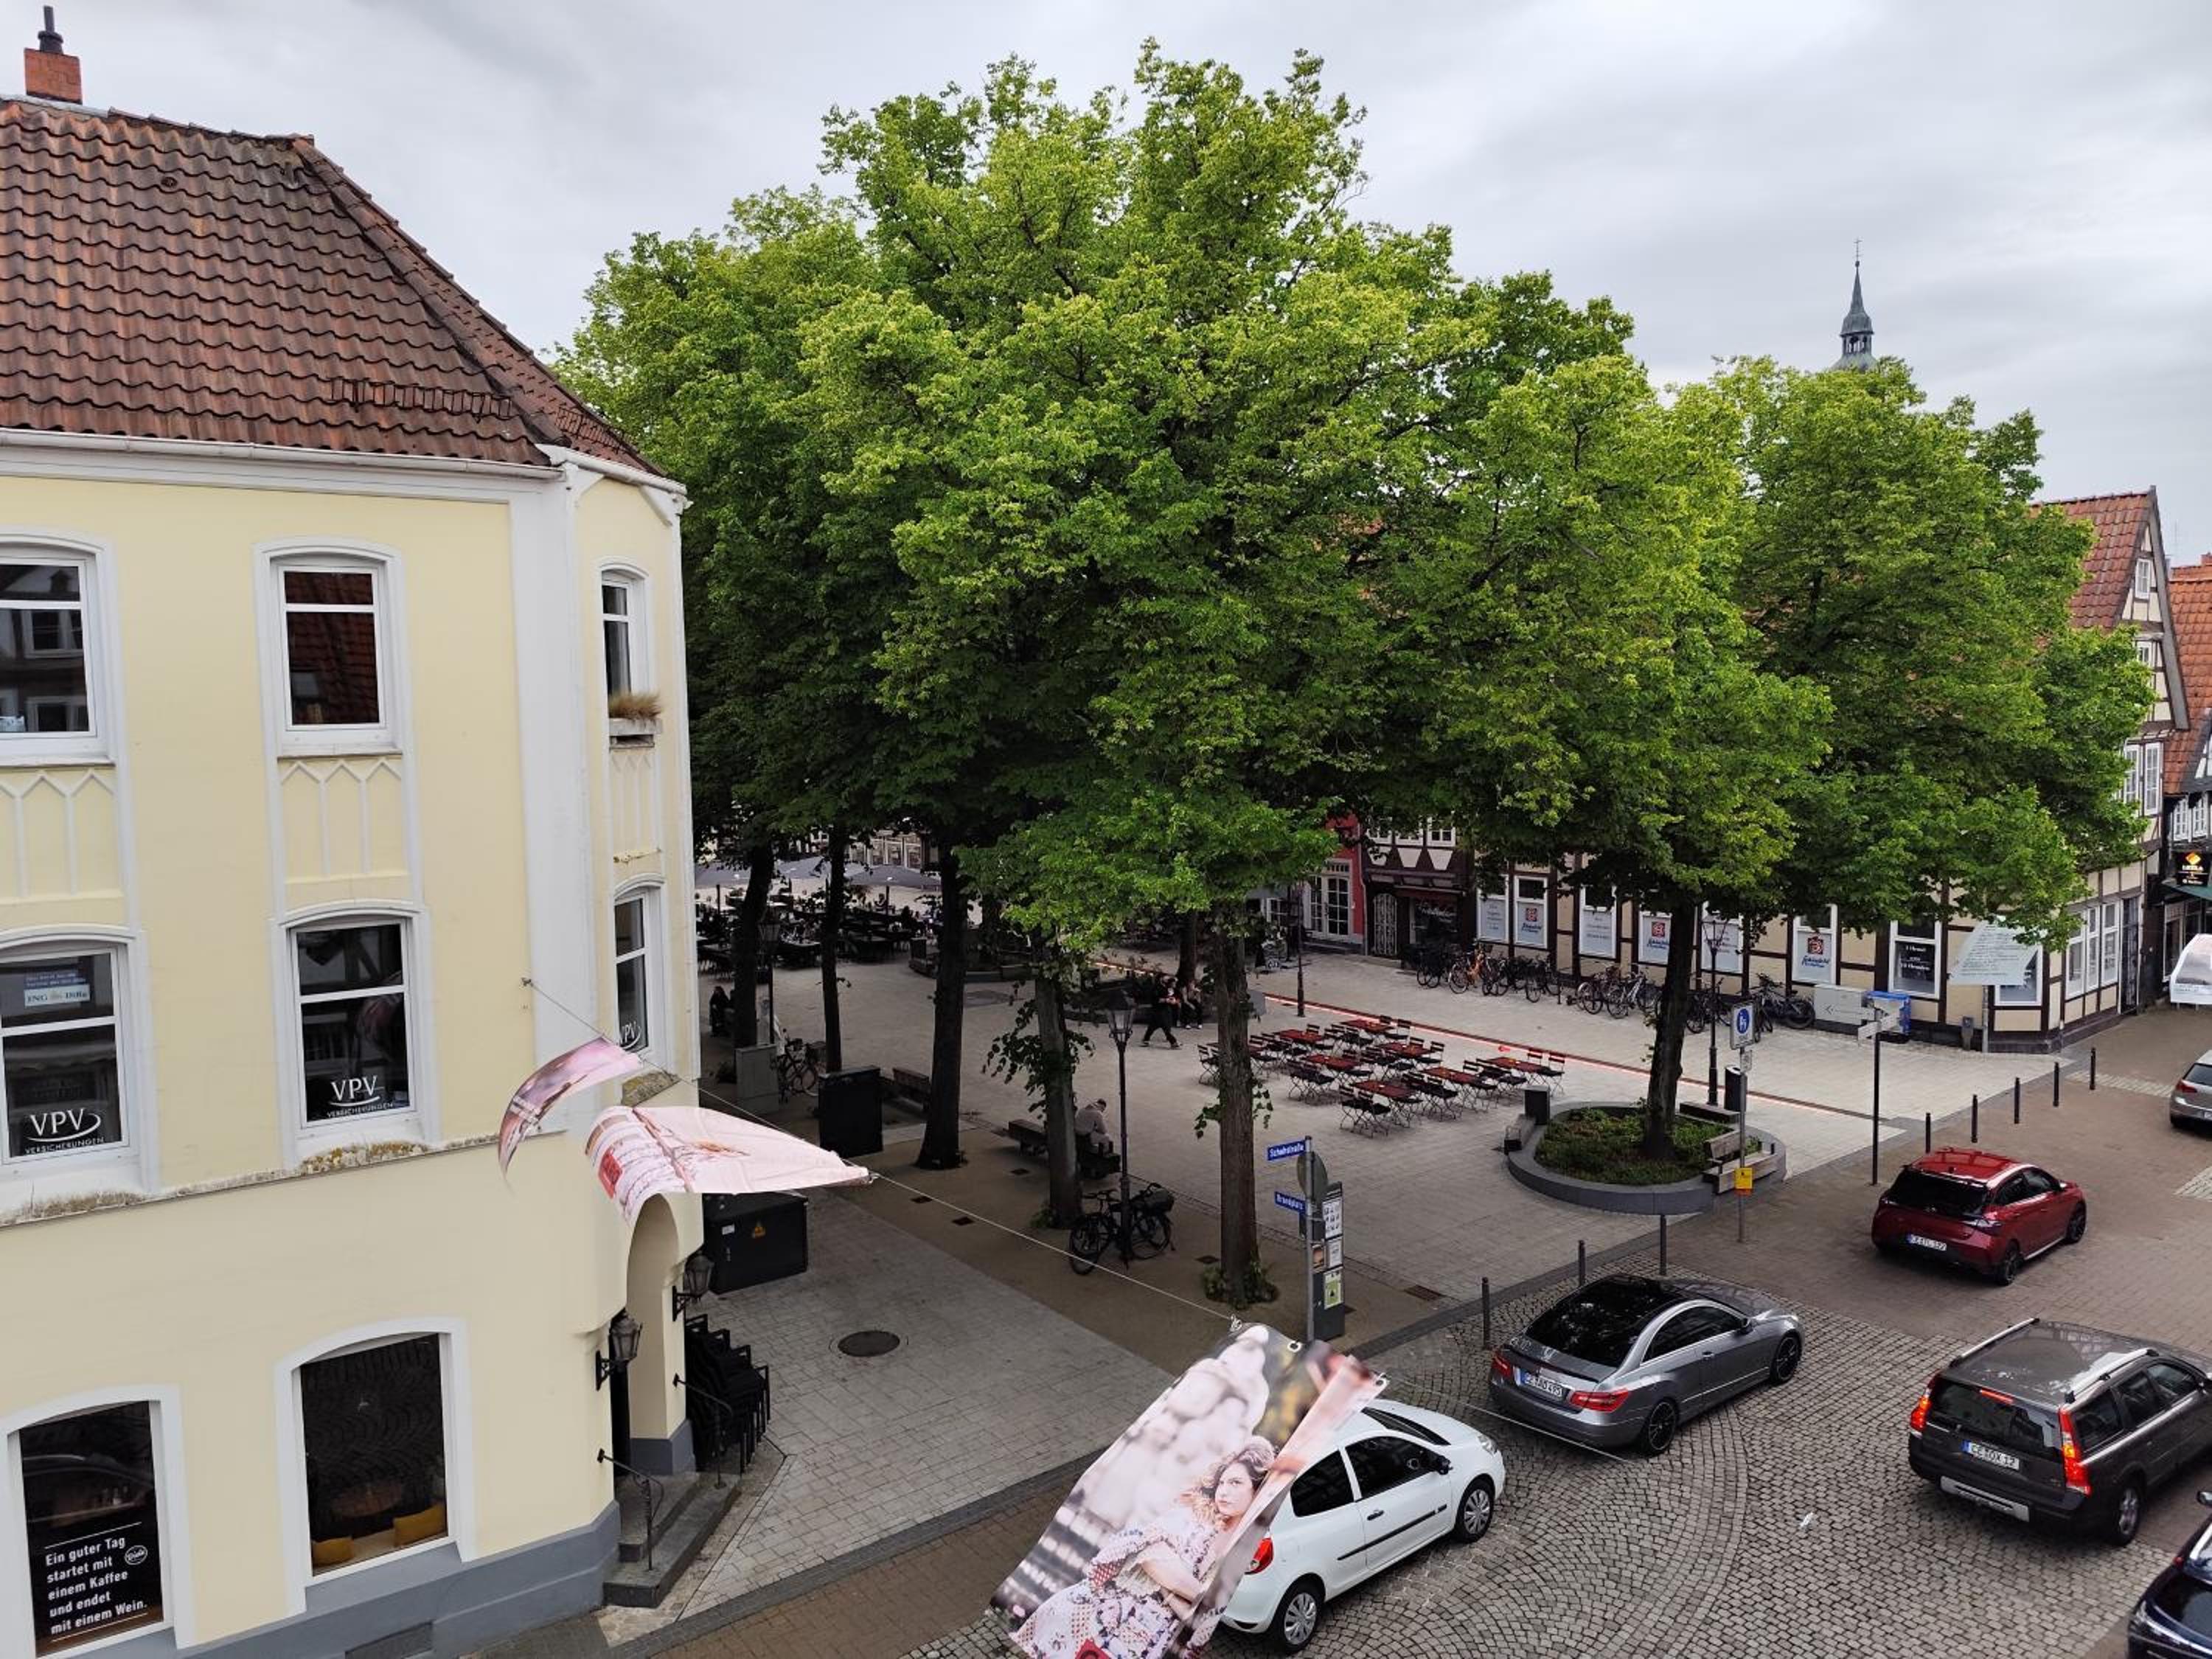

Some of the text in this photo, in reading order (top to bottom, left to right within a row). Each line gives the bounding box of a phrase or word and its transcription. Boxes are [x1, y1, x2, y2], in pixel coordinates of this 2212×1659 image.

[330, 1075, 378, 1101] VPV
[29, 1107, 86, 1135] VPV
[24, 1137, 105, 1154] VERSICHERUNGEN
[46, 1537, 125, 1566] Ein guter Tag
[46, 1556, 113, 1583] startet mit
[48, 1571, 128, 1600] einem Kaffee
[49, 1591, 111, 1618] und endet
[51, 1599, 147, 1635] mit einem Wein.
